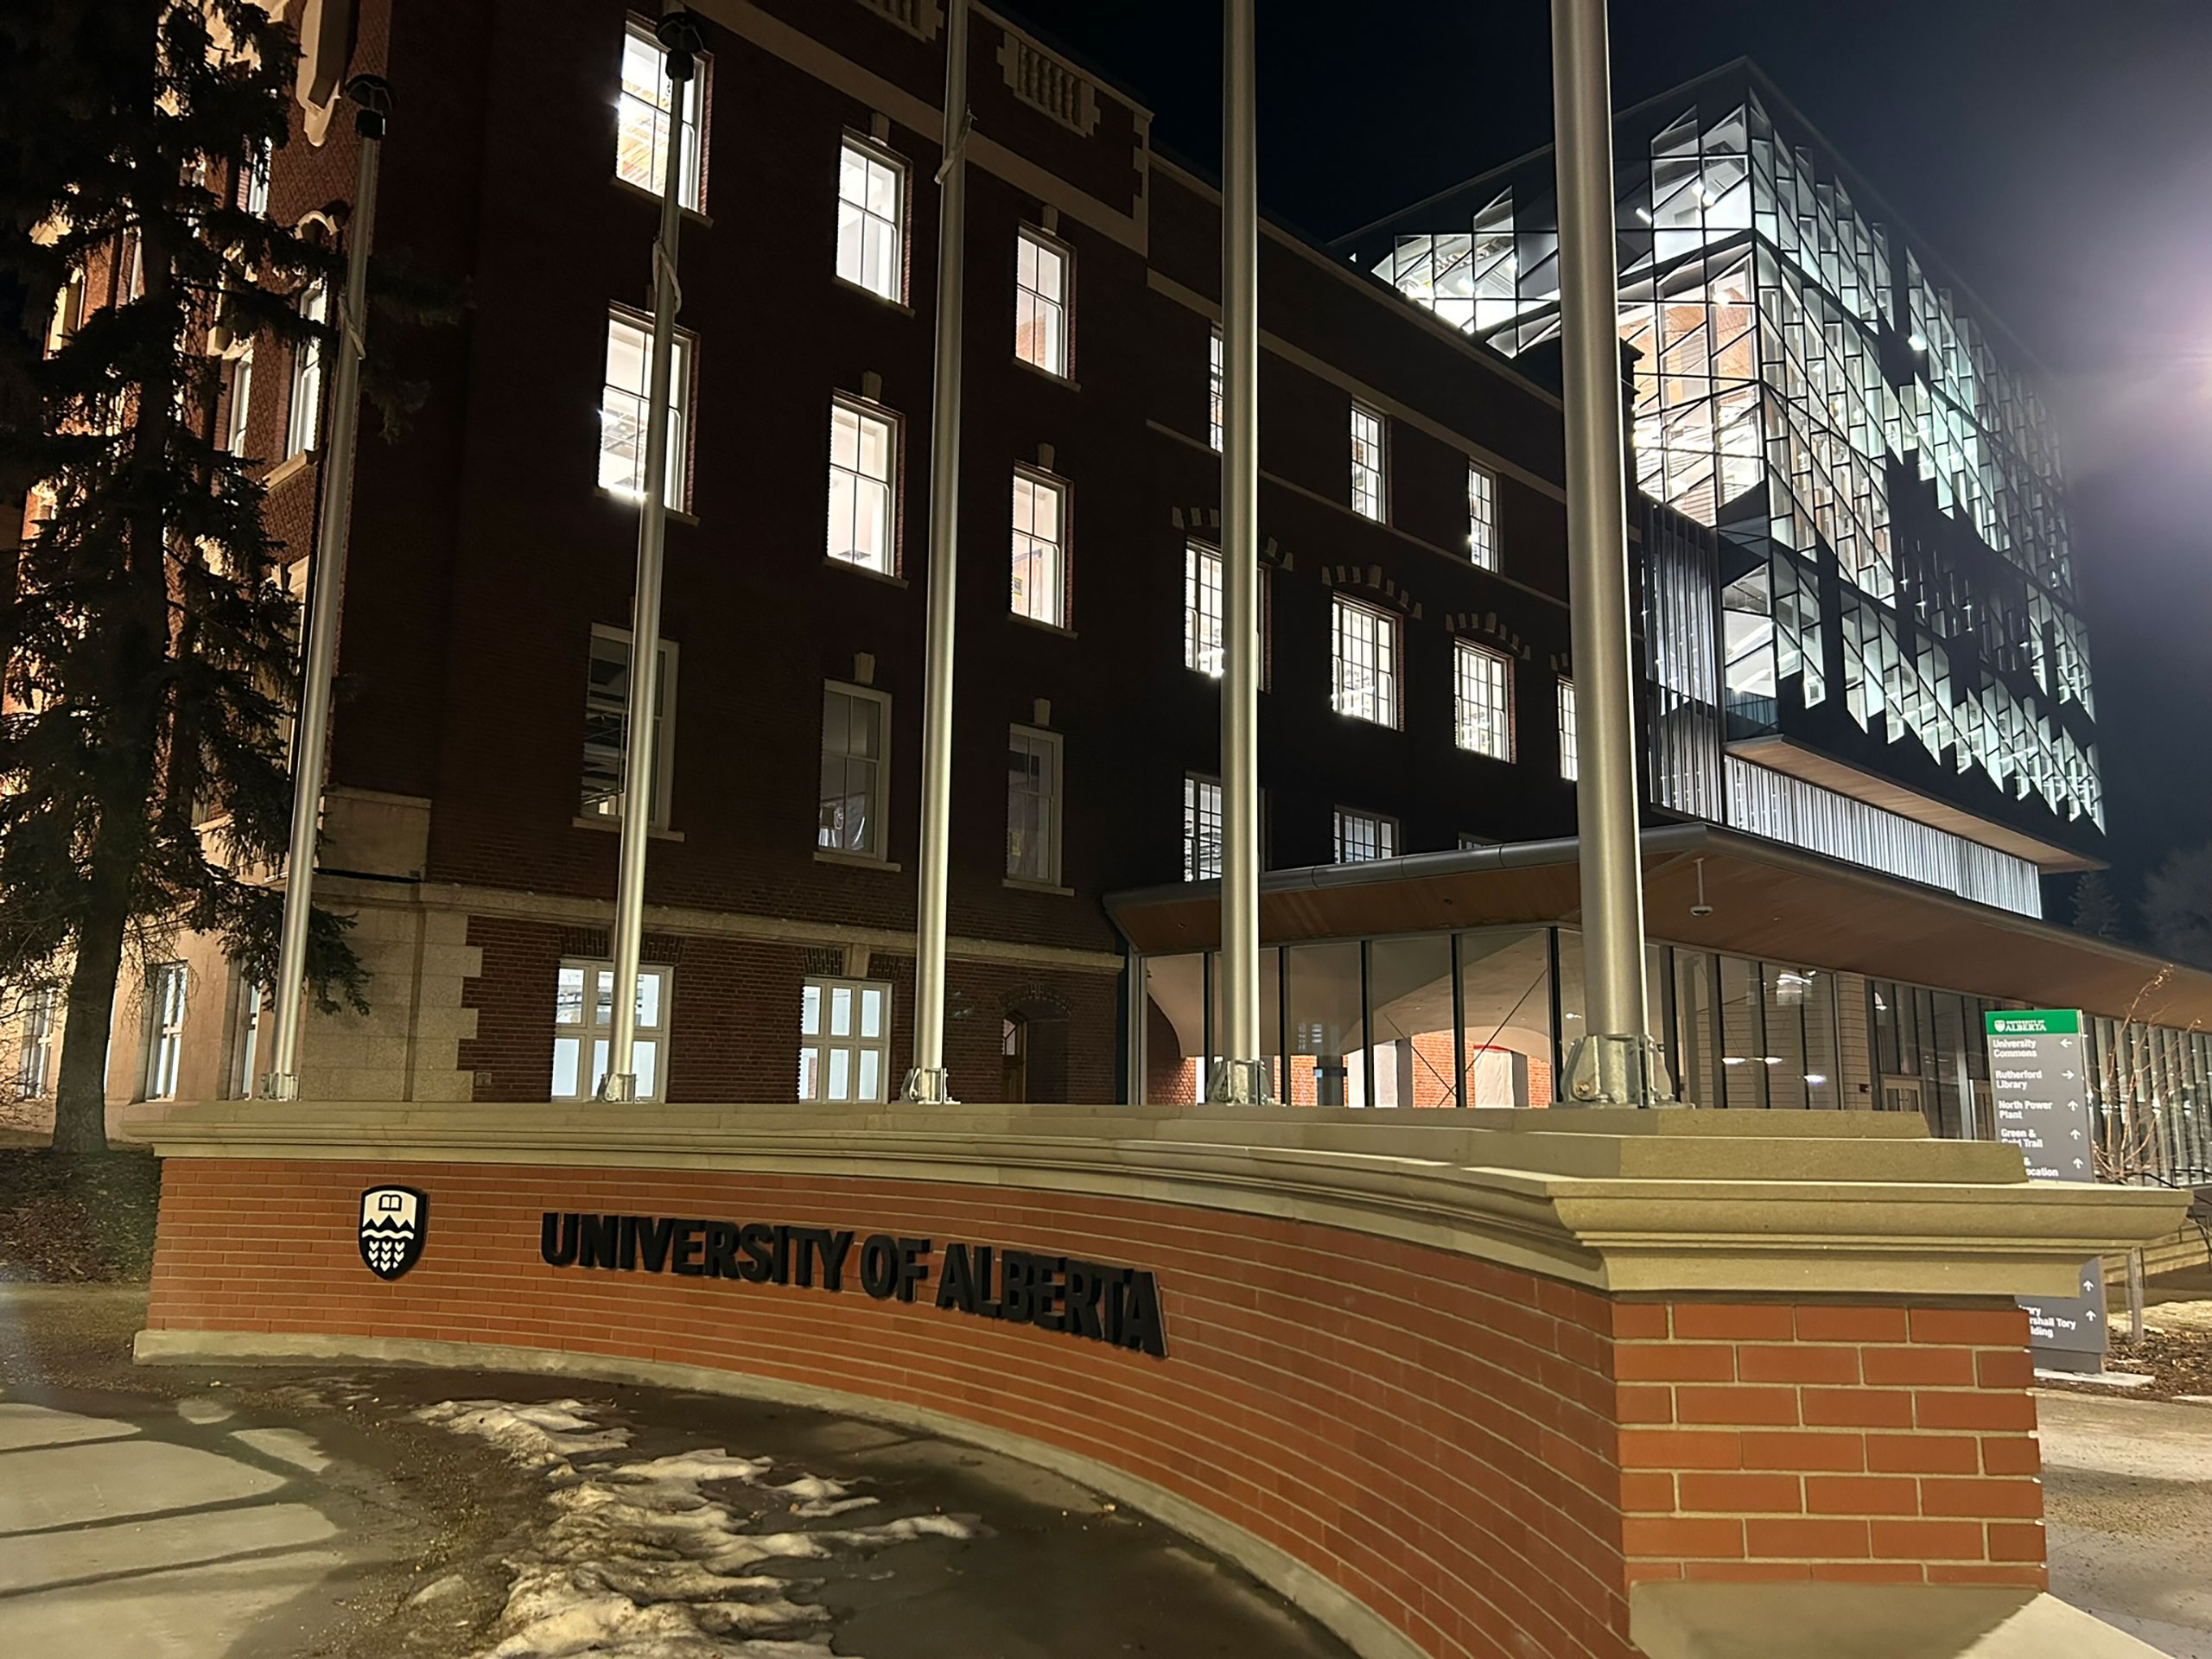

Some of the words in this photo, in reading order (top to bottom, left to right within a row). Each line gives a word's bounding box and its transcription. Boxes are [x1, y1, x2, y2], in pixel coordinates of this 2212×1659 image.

[1993, 1039, 2037, 1049] University
[1993, 1049, 2037, 1058] Commons
[1995, 1070, 2043, 1078] Rutherford
[1996, 1079, 2027, 1090] Library
[1998, 1100, 2023, 1109] North
[2024, 1100, 2053, 1109] Power
[1999, 1109, 2023, 1119] Plant
[2000, 1128, 2027, 1138] Green
[2028, 1128, 2037, 1138] &
[2023, 1138, 2044, 1147] Trail
[2025, 1166, 2059, 1177] ocation
[540, 1211, 855, 1291] UNIVERSITY
[860, 1234, 931, 1302] OF
[935, 1243, 1169, 1359] ALBERTA
[2029, 1316, 2055, 1327] rshall
[2056, 1318, 2076, 1331] Tory
[2030, 1325, 2054, 1338] lding
